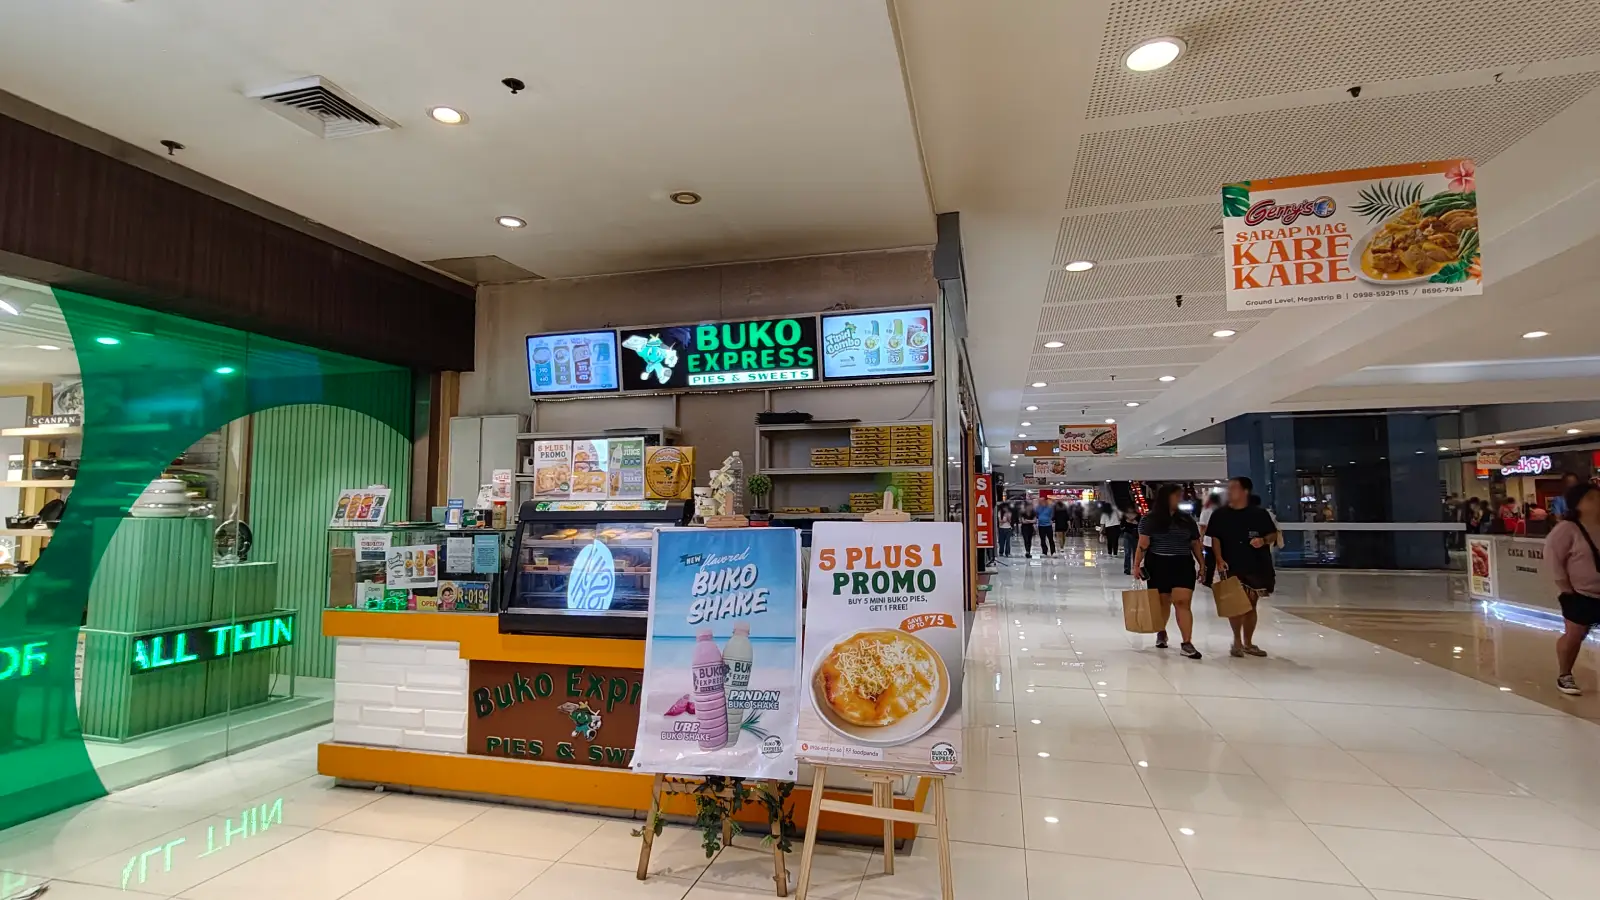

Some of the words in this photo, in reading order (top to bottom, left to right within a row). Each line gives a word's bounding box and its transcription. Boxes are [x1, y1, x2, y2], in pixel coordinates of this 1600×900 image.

[1244, 199, 1314, 226] Gerry's
[1236, 227, 1301, 242] SARAP
[1306, 223, 1347, 236] MAG
[1231, 234, 1353, 266] KARE
[1232, 259, 1357, 290] KARE
[1245, 298, 1272, 306] Ground
[1297, 294, 1335, 303] Megastrip
[1421, 286, 1463, 294] 8696-7941
[696, 319, 801, 351] BUKO
[826, 338, 861, 354] Combo
[688, 346, 814, 373] EXPRESS
[692, 375, 725, 384] PIES
[731, 374, 741, 382] &
[748, 370, 809, 381] SWEETS
[32, 416, 77, 424] SCANPAN
[623, 448, 640, 456] JUICE
[976, 478, 989, 544] SALE
[686, 556, 701, 564] NEW
[701, 545, 751, 572] flavored
[818, 549, 836, 571] 5
[845, 544, 923, 570] PLUS
[931, 543, 943, 567] 1
[692, 564, 758, 597] BUKO
[833, 569, 936, 595] PROMO
[687, 588, 770, 625] SHAKE
[887, 596, 909, 604] BUKO
[910, 595, 928, 603] PIES,
[907, 616, 922, 625] SAVE
[134, 633, 198, 670] ALL
[207, 615, 292, 656] THIN
[473, 672, 554, 719] Buko
[728, 690, 780, 701] PANDAN
[728, 701, 751, 710] BUKO
[751, 701, 779, 710] SHAKE
[661, 732, 684, 741] BUKO
[684, 732, 711, 741] SHAKE
[674, 721, 700, 733] UBE
[486, 736, 544, 757] PIES
[556, 742, 576, 760] &
[852, 748, 879, 757] foodpanda
